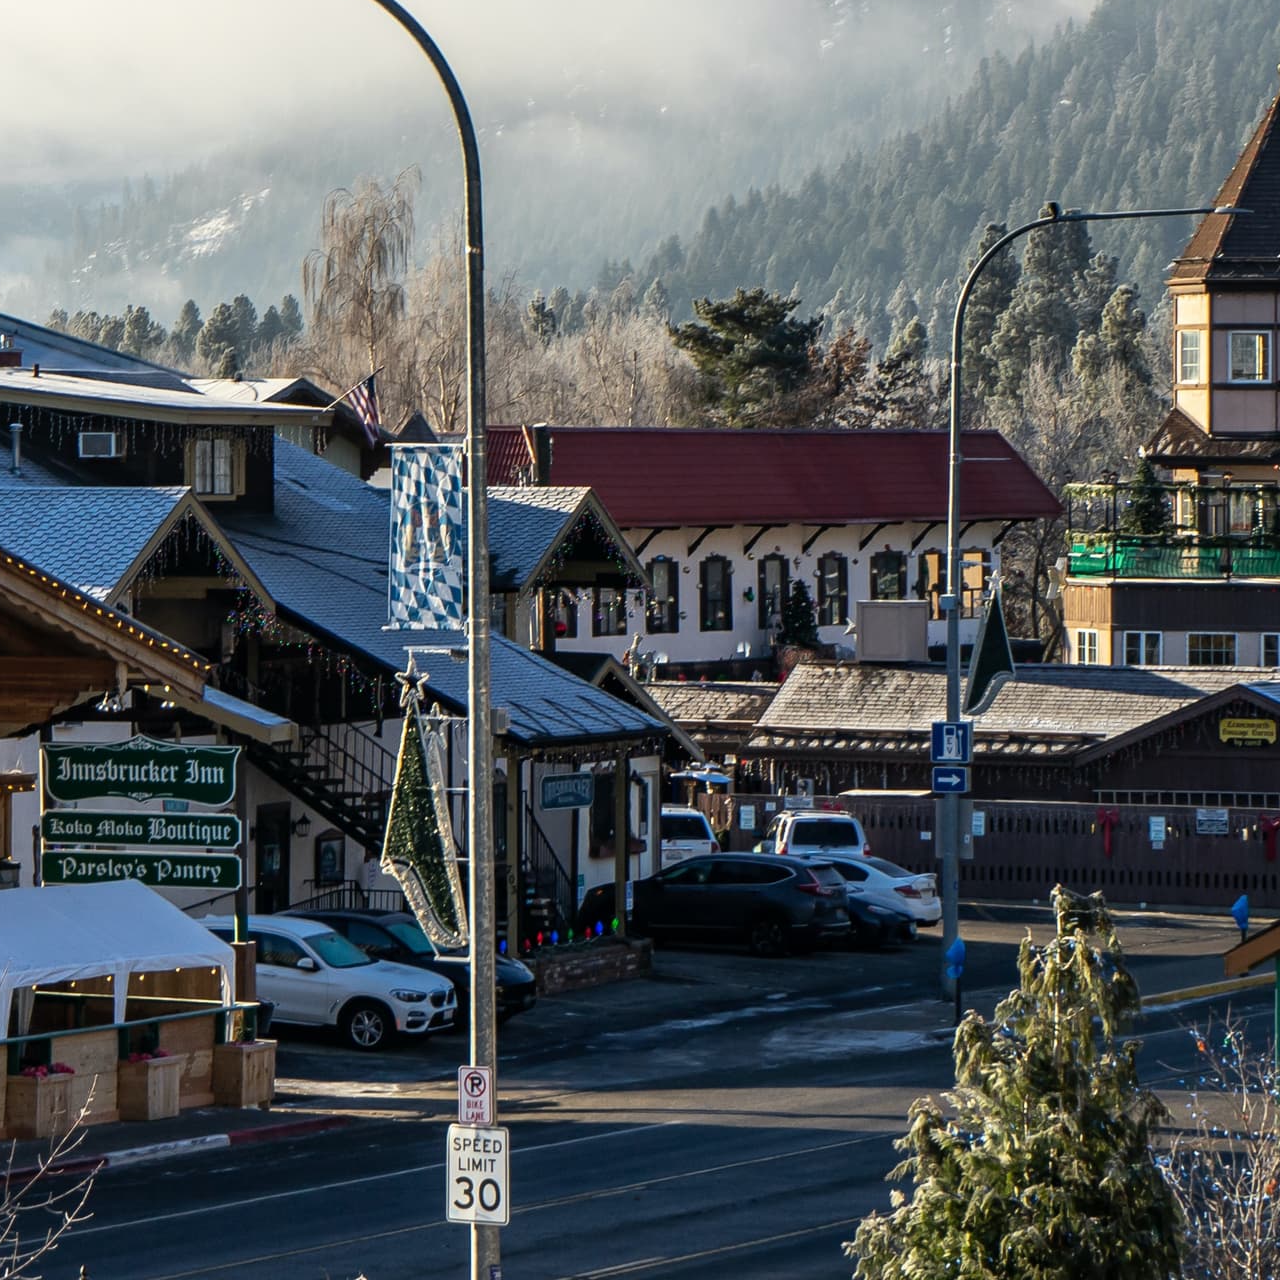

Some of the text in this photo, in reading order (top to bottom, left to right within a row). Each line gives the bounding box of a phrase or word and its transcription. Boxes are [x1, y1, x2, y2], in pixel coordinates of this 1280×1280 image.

[56, 756, 225, 785] Innsbrucker Inn
[49, 818, 232, 844] Koko Moko Boutique
[58, 857, 222, 883] Parsley's Pantry
[466, 1100, 484, 1110] BIKE
[465, 1111, 485, 1121] LANE
[453, 1137, 503, 1154] SPEED
[458, 1157, 497, 1173] LIMIT
[453, 1176, 501, 1212] 30
